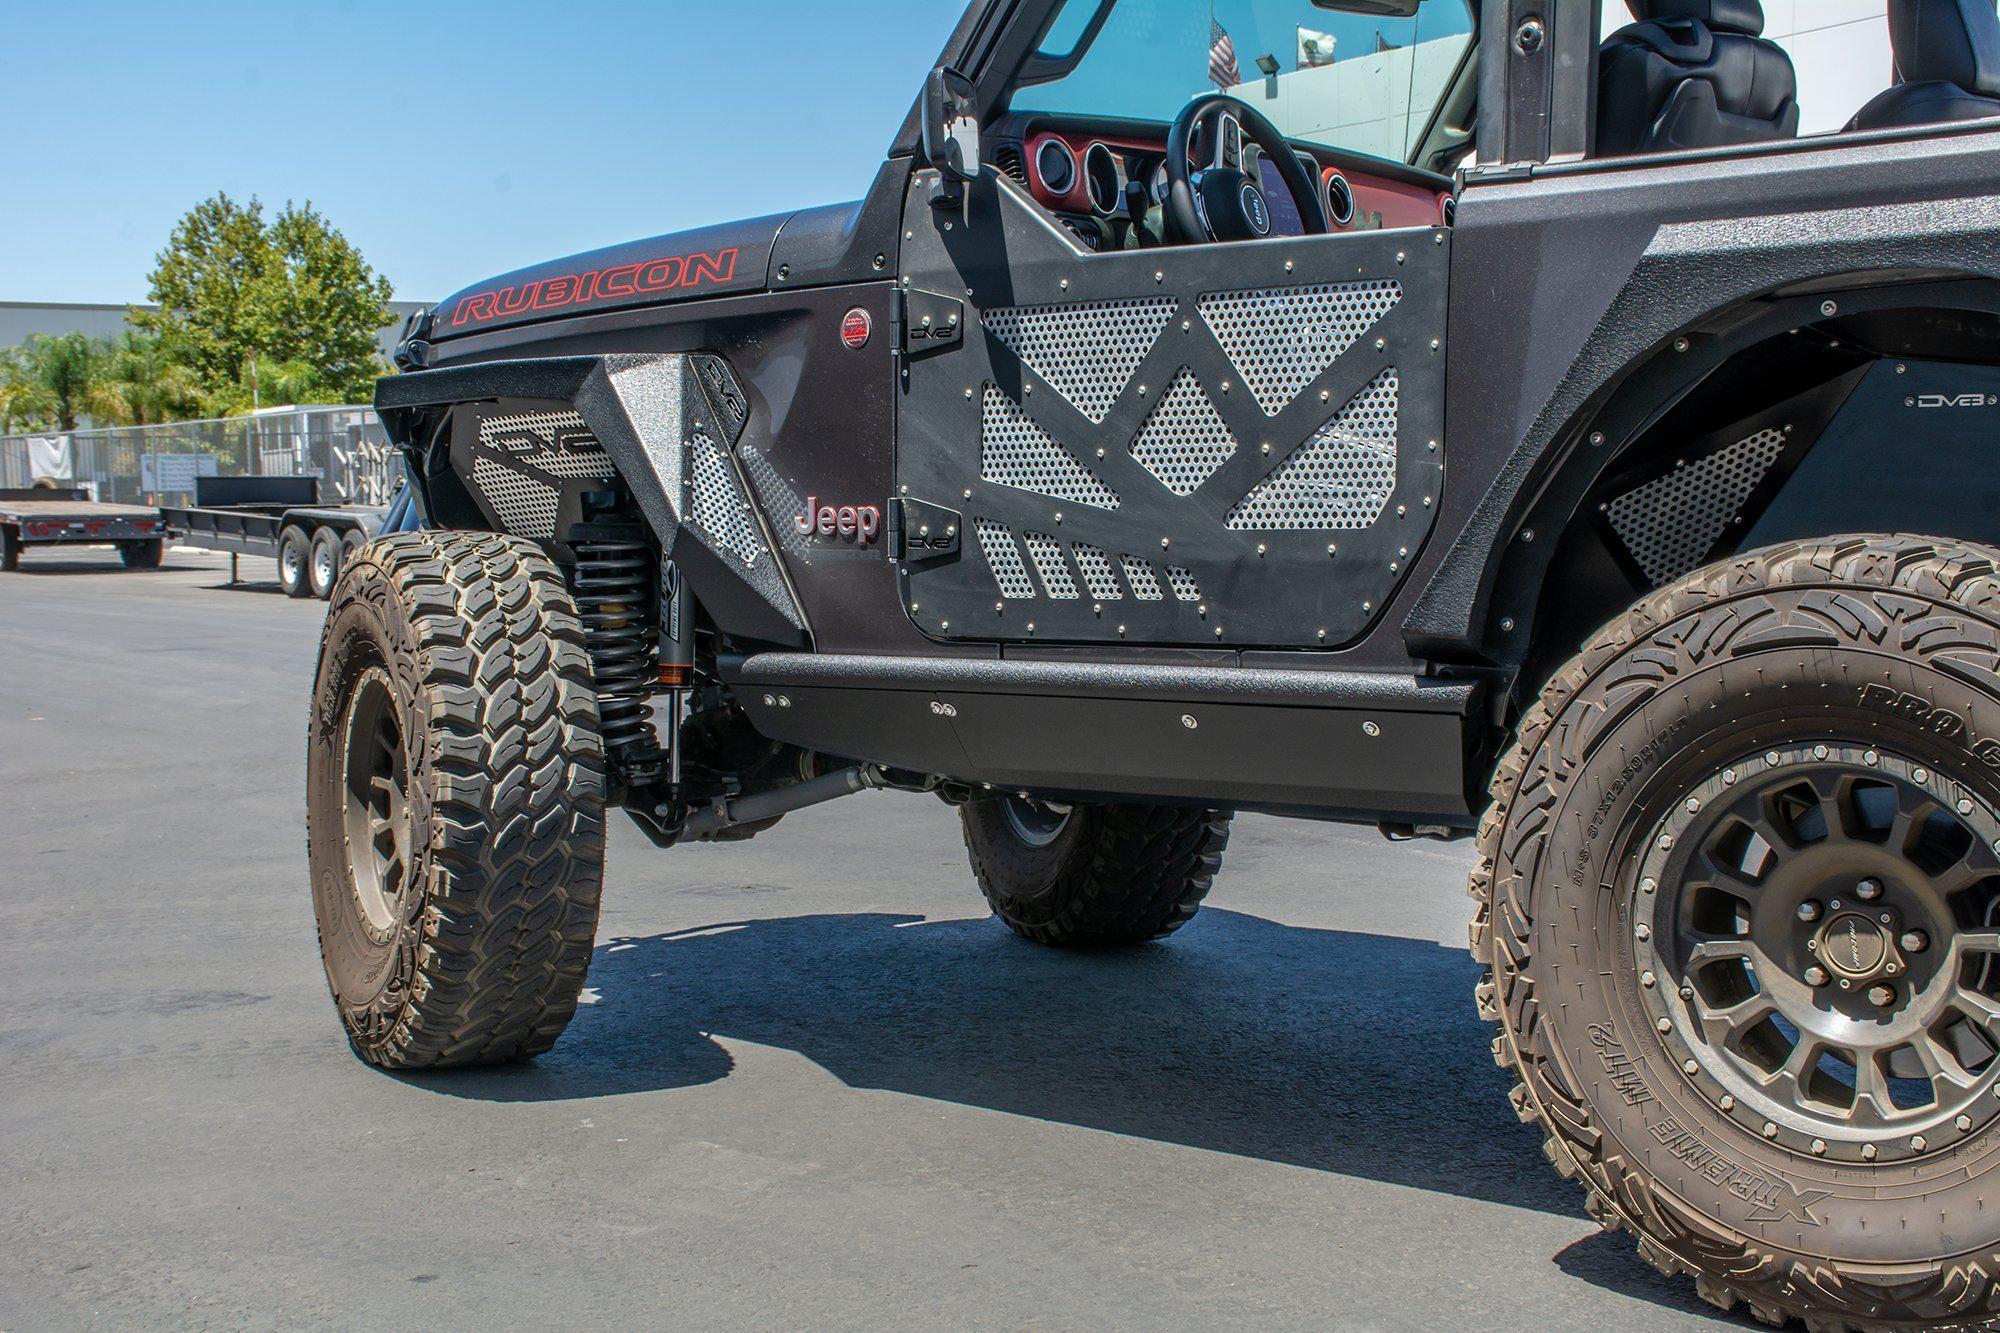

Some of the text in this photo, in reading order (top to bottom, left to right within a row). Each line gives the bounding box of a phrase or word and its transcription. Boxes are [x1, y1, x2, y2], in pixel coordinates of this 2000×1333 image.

[452, 248, 739, 326] RUBICON
[795, 496, 880, 544] Jeep
[1857, 683, 1965, 737] PRO
[1587, 1022, 1655, 1106] MT2
[1647, 1116, 1835, 1226] XTREME
